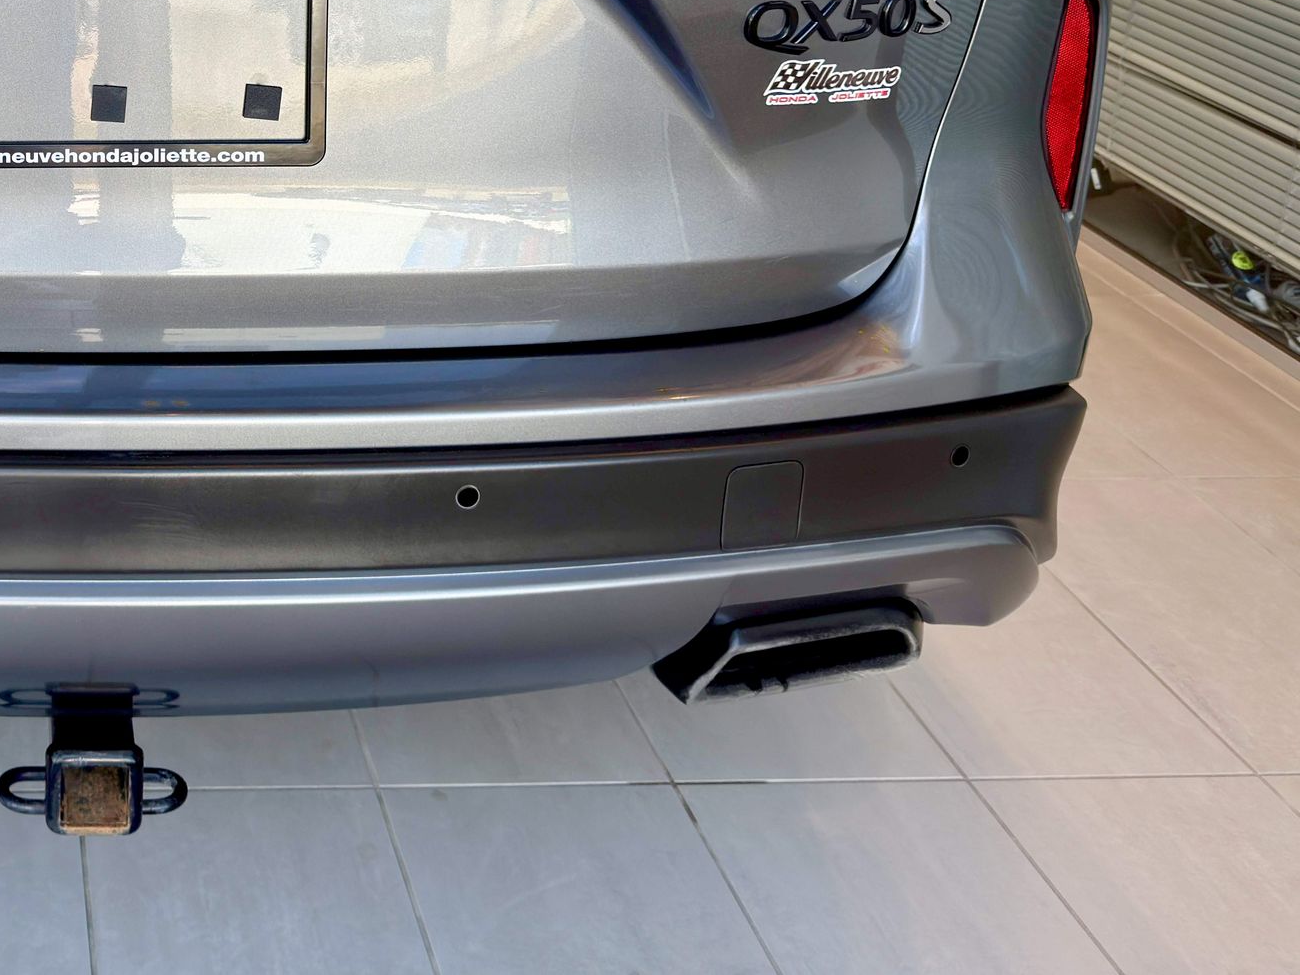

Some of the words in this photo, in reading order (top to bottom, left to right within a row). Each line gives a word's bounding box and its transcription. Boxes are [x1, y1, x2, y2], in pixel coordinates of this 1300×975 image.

[793, 61, 900, 91] Villeneuve
[769, 95, 817, 104] HONDA
[831, 90, 889, 101] JOLIETTE
